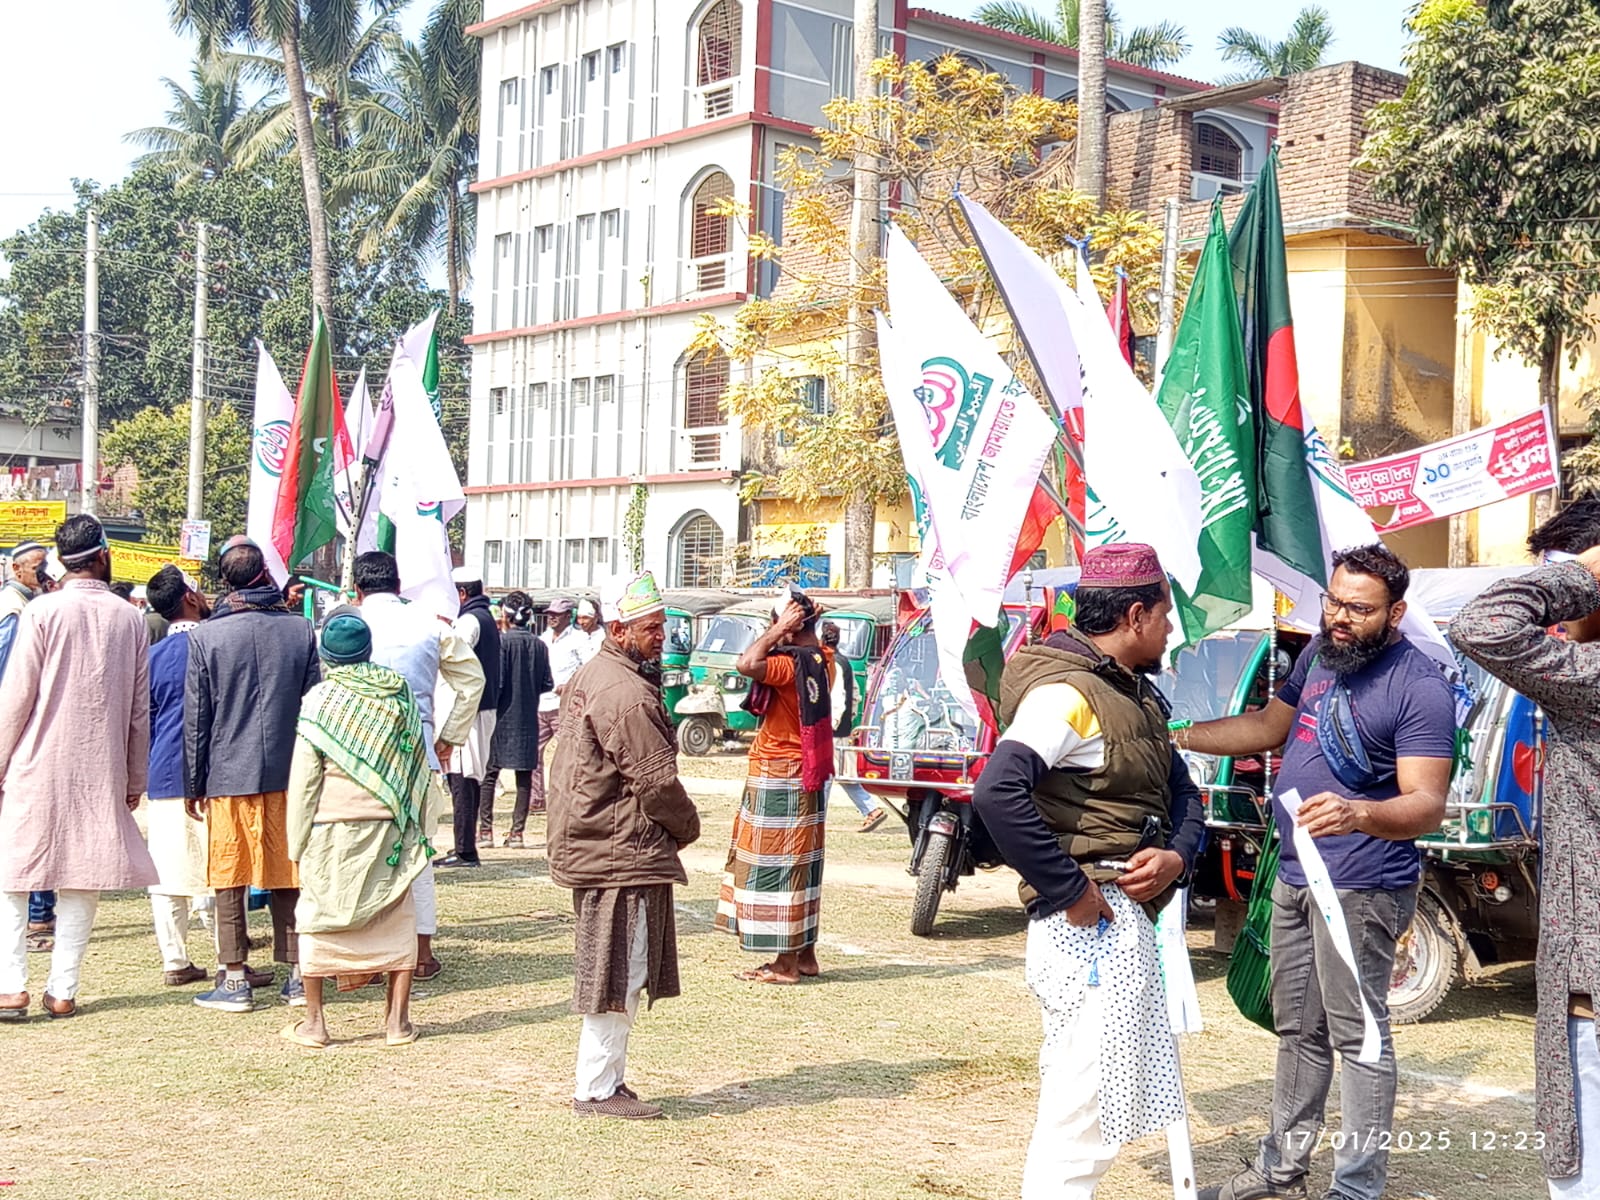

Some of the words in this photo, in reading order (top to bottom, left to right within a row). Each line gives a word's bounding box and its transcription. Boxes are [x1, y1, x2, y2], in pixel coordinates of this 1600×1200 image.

[961, 458, 995, 521] বাংলাদেশ
[981, 398, 1016, 458] জামায়াতে
[1372, 471, 1391, 486] ৭ম
[1392, 466, 1412, 482] ৮ম
[1424, 463, 1450, 482] ১০
[1379, 488, 1406, 503] ১০ম
